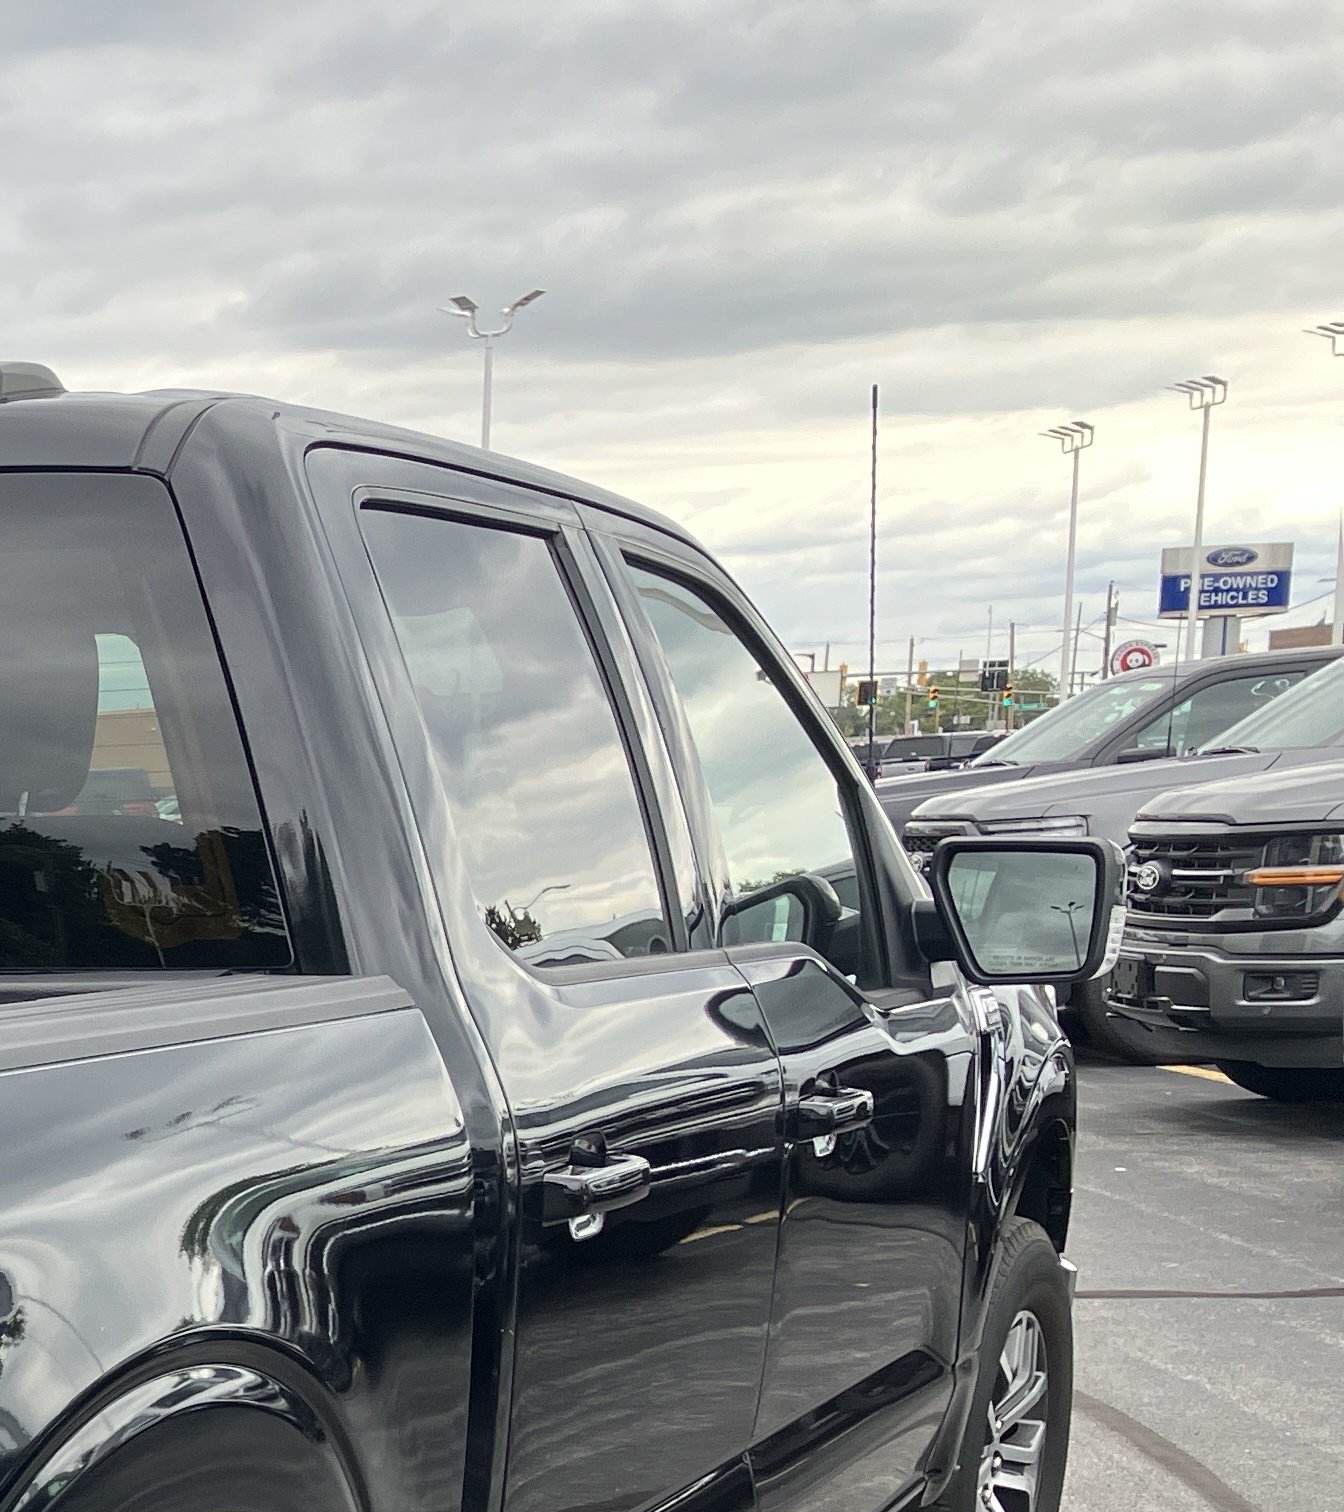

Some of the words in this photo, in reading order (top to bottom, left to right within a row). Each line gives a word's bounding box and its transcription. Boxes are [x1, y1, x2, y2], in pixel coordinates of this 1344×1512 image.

[1217, 551, 1250, 564] Ford
[1180, 574, 1279, 592] PE-OWNED
[1196, 589, 1269, 606] EHICLES
